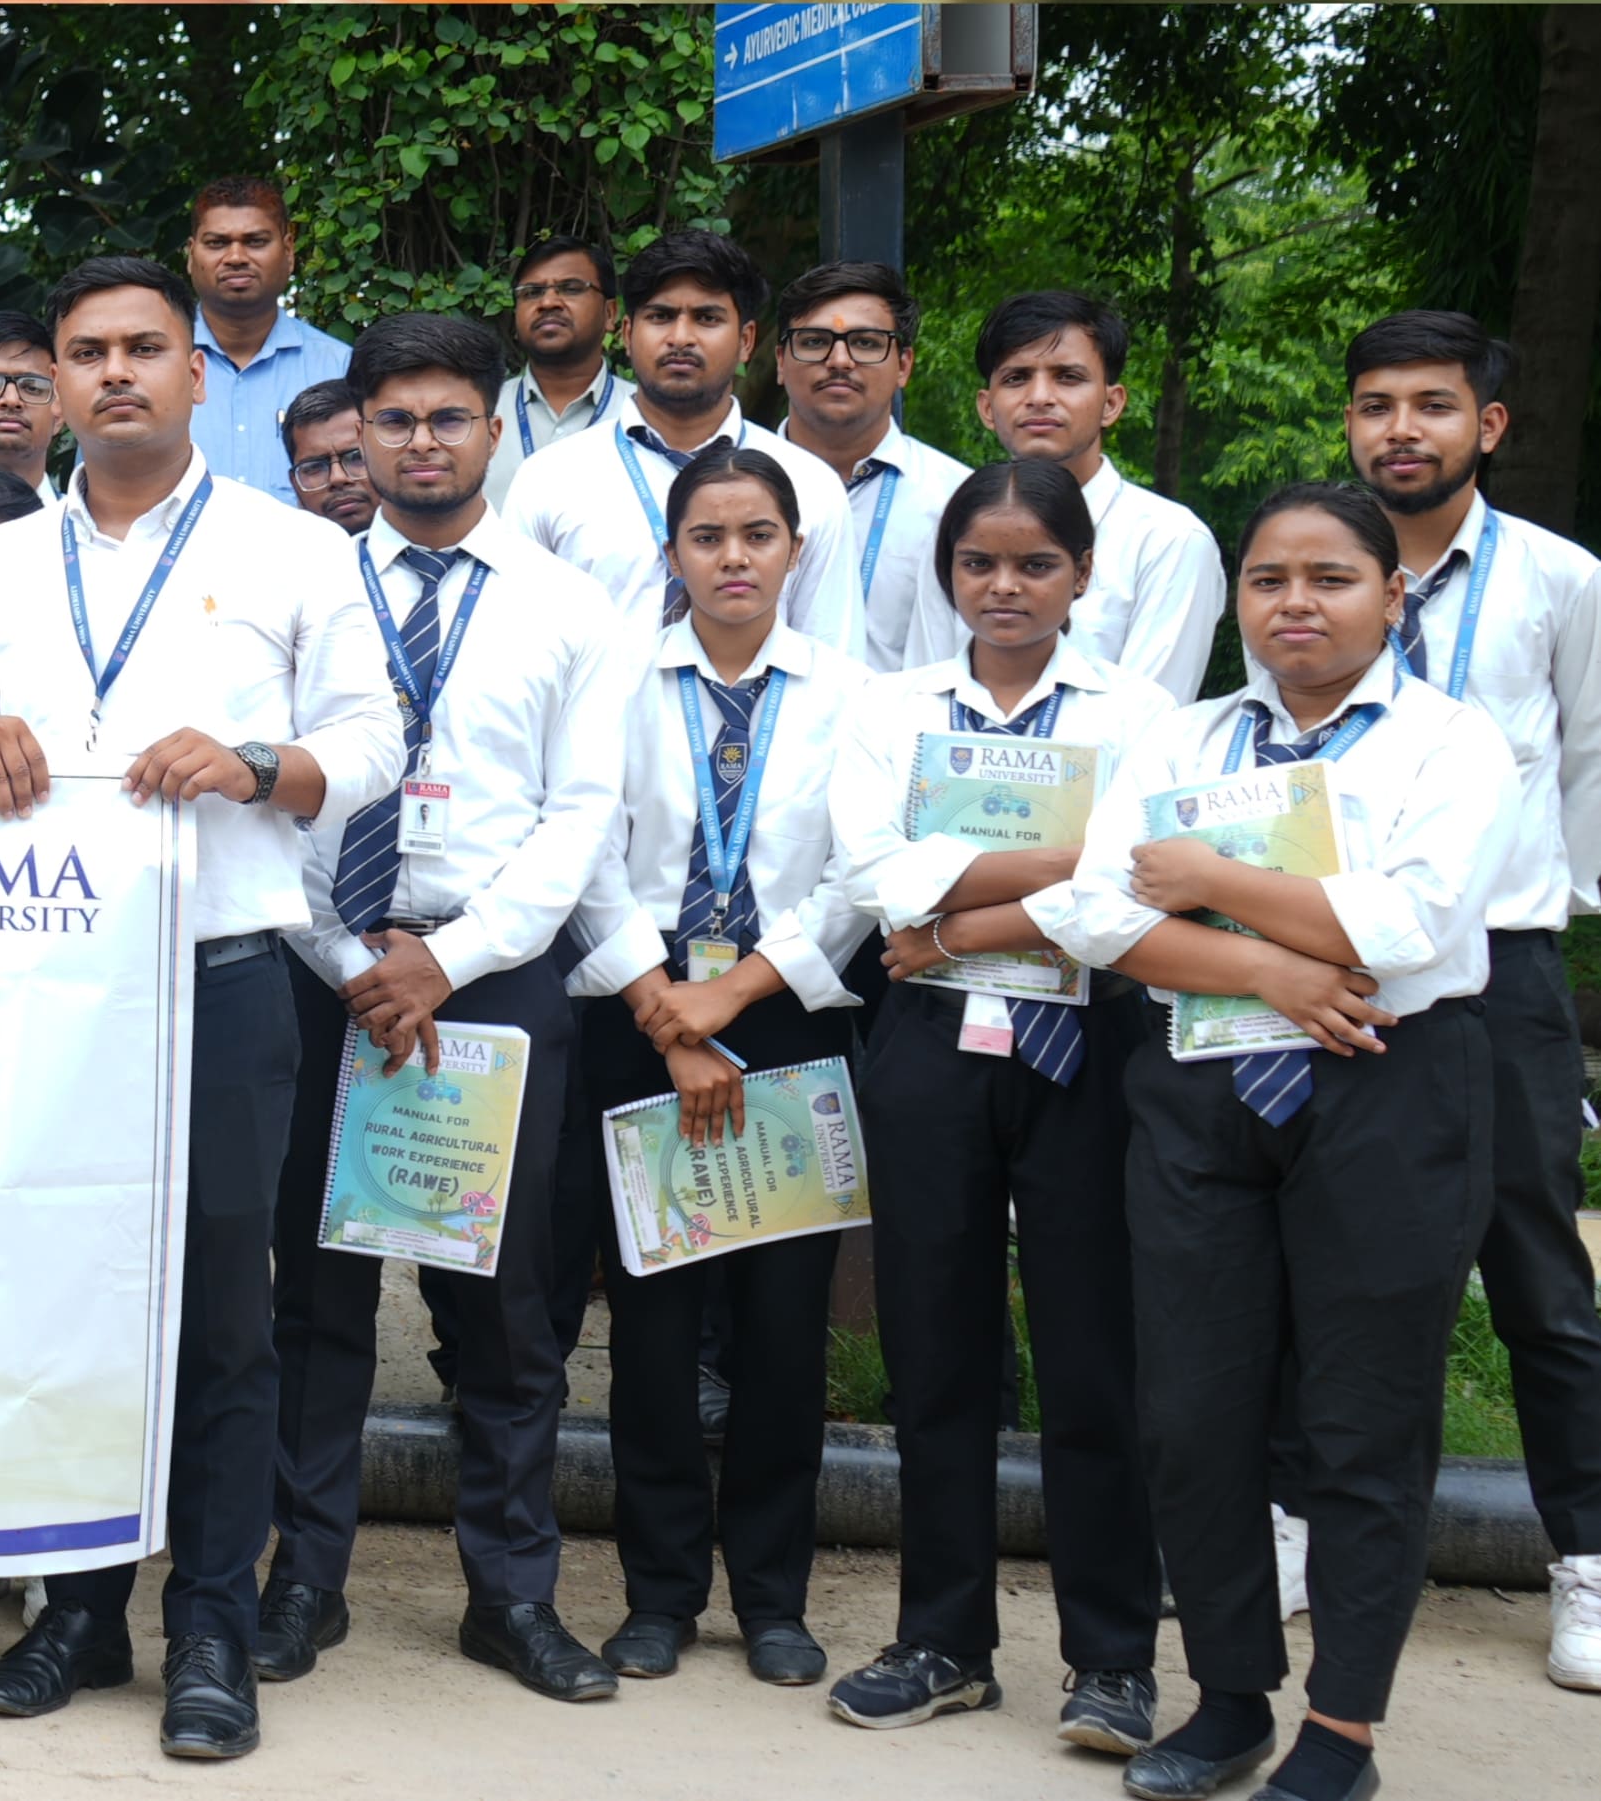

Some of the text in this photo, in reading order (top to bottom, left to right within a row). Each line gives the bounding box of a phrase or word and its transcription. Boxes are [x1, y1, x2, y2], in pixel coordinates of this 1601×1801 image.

[743, 3, 850, 65] AYURVEDIC MEDICAL
[168, 496, 203, 556] RAMA UNIVERSITY
[1468, 541, 1494, 615] RAMA UNIVERSITY
[69, 584, 86, 644] RAMA UNIVERSITY
[120, 587, 156, 651] RAMA UNIVERSITY
[390, 640, 420, 700] RAMA UNIVERSITY
[437, 616, 465, 677] RAMA UNIVERSITY
[681, 677, 701, 752] RAMA UNIVERSITY
[755, 680, 781, 756] RAMA UNIVERSITY
[978, 768, 1056, 786] UNIVERSITY
[980, 748, 1056, 772] RAMA
[700, 787, 721, 865] RAMA UNIVERSITY
[726, 790, 755, 871] RAMA UNIVERSITY
[959, 825, 1042, 842] MANUAL FOR
[364, 1122, 500, 1155] RURAL AGRICULTURAL
[392, 1105, 470, 1127] MANUAL FOR
[371, 1144, 485, 1174] WORK EXPERIENCE
[387, 1165, 459, 1197] (RAWE)
[754, 1120, 778, 1192] MANUAL FOR
[814, 1123, 837, 1190] UNIVERSITY
[827, 1121, 856, 1187] RAMA
[715, 1152, 739, 1223] EXPERIENCE
[735, 1145, 763, 1229] AGRICULTURAL
